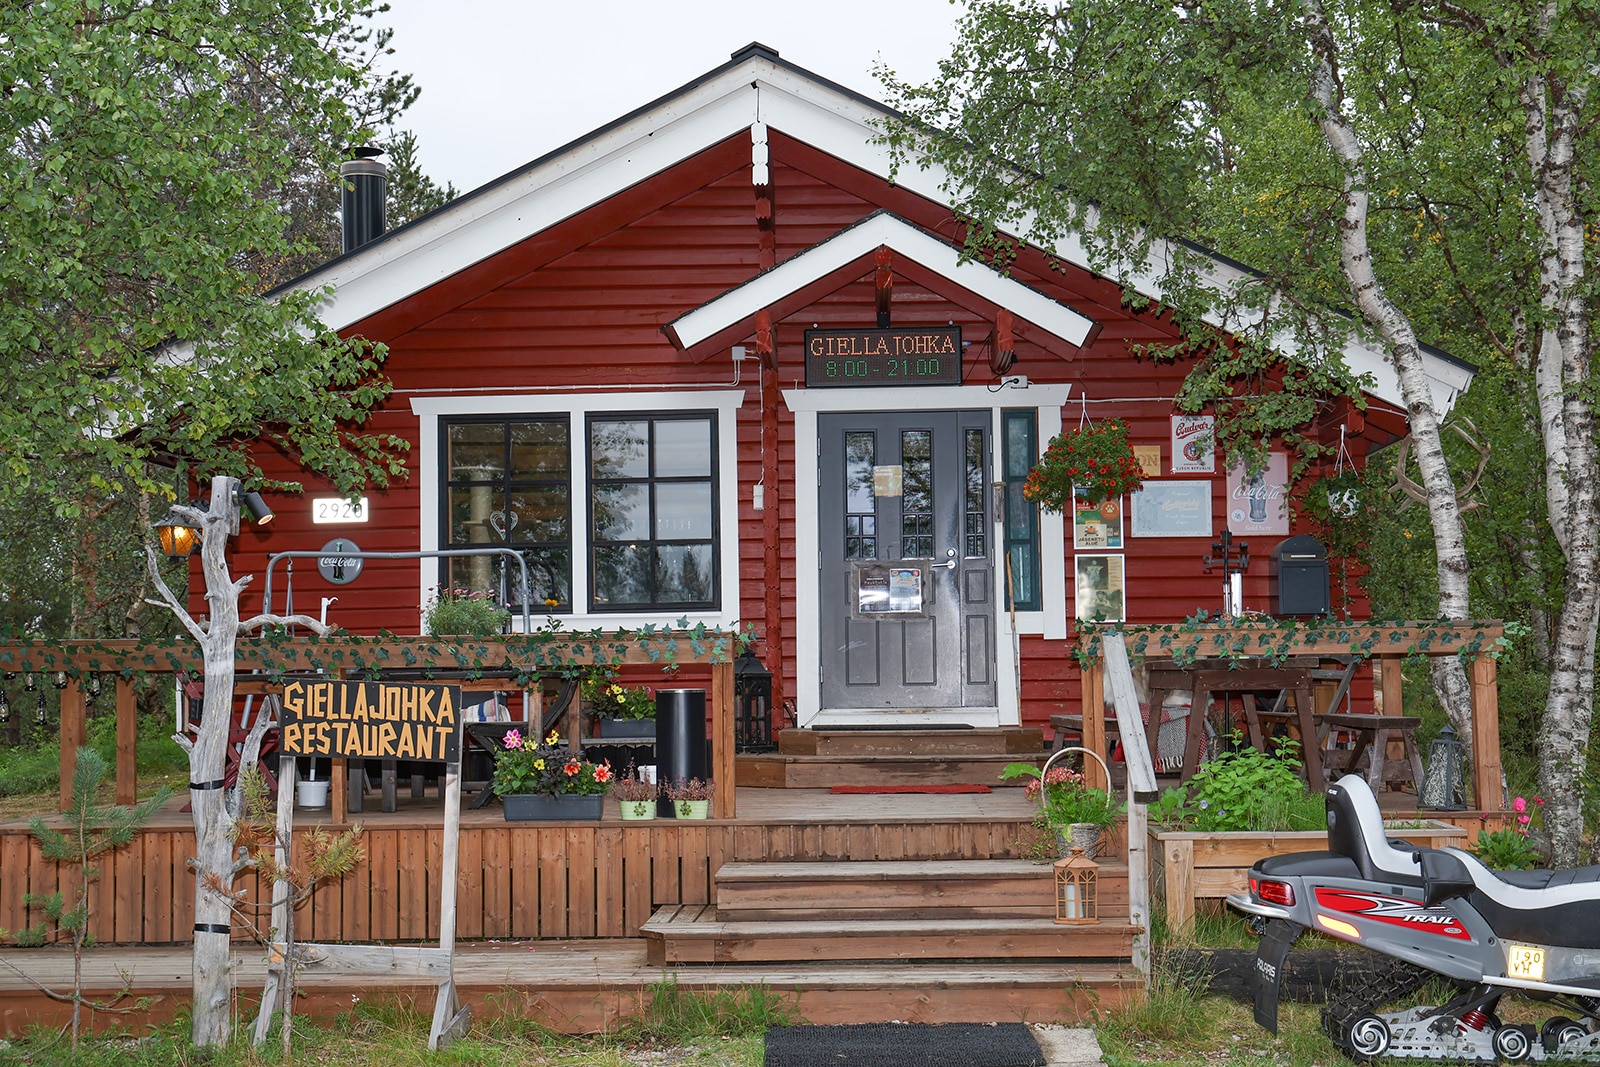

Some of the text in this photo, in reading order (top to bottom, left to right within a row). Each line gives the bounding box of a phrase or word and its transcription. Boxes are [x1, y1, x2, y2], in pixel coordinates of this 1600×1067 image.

[826, 360, 868, 377] 8:00
[887, 358, 940, 376] 21:00
[283, 681, 455, 726] GIELLAJOHKA
[283, 721, 454, 760] RESTAURANT
[1403, 914, 1455, 925] TRAIL
[1515, 951, 1541, 963] 190
